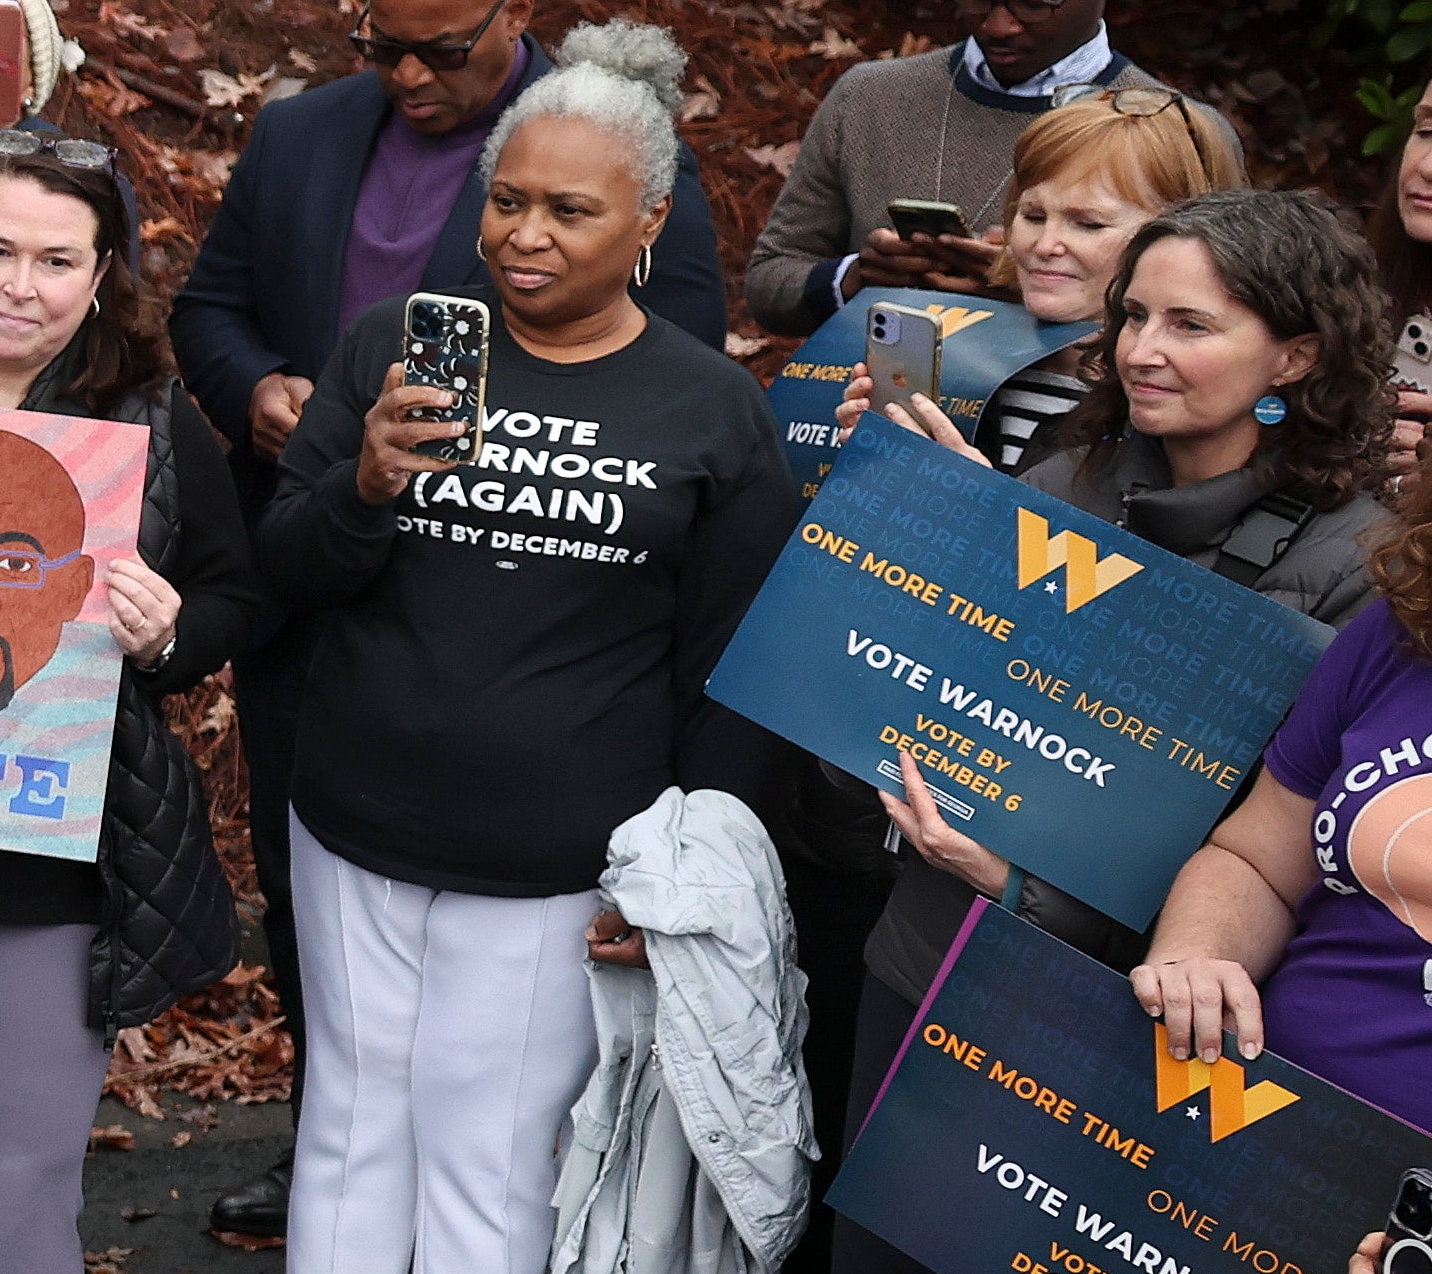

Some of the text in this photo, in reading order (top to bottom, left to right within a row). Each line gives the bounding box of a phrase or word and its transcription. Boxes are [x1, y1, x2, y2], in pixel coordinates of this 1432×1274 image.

[782, 362, 811, 379] ONE
[484, 407, 600, 447] VOTE
[786, 421, 827, 446] VOTE
[414, 472, 625, 536] (AGAIN)
[451, 524, 649, 565] BY DECEMBER 6
[801, 523, 1015, 643] ONE MORE TIME
[846, 629, 1116, 788] VOTE WARNOCK
[1005, 659, 1241, 791] ONE MORE TIME
[913, 713, 978, 763] VOTE
[923, 1023, 1155, 1171] ONE MORE TIME
[976, 1143, 1066, 1219] VOTE
[1145, 1188, 1215, 1241] ONE
